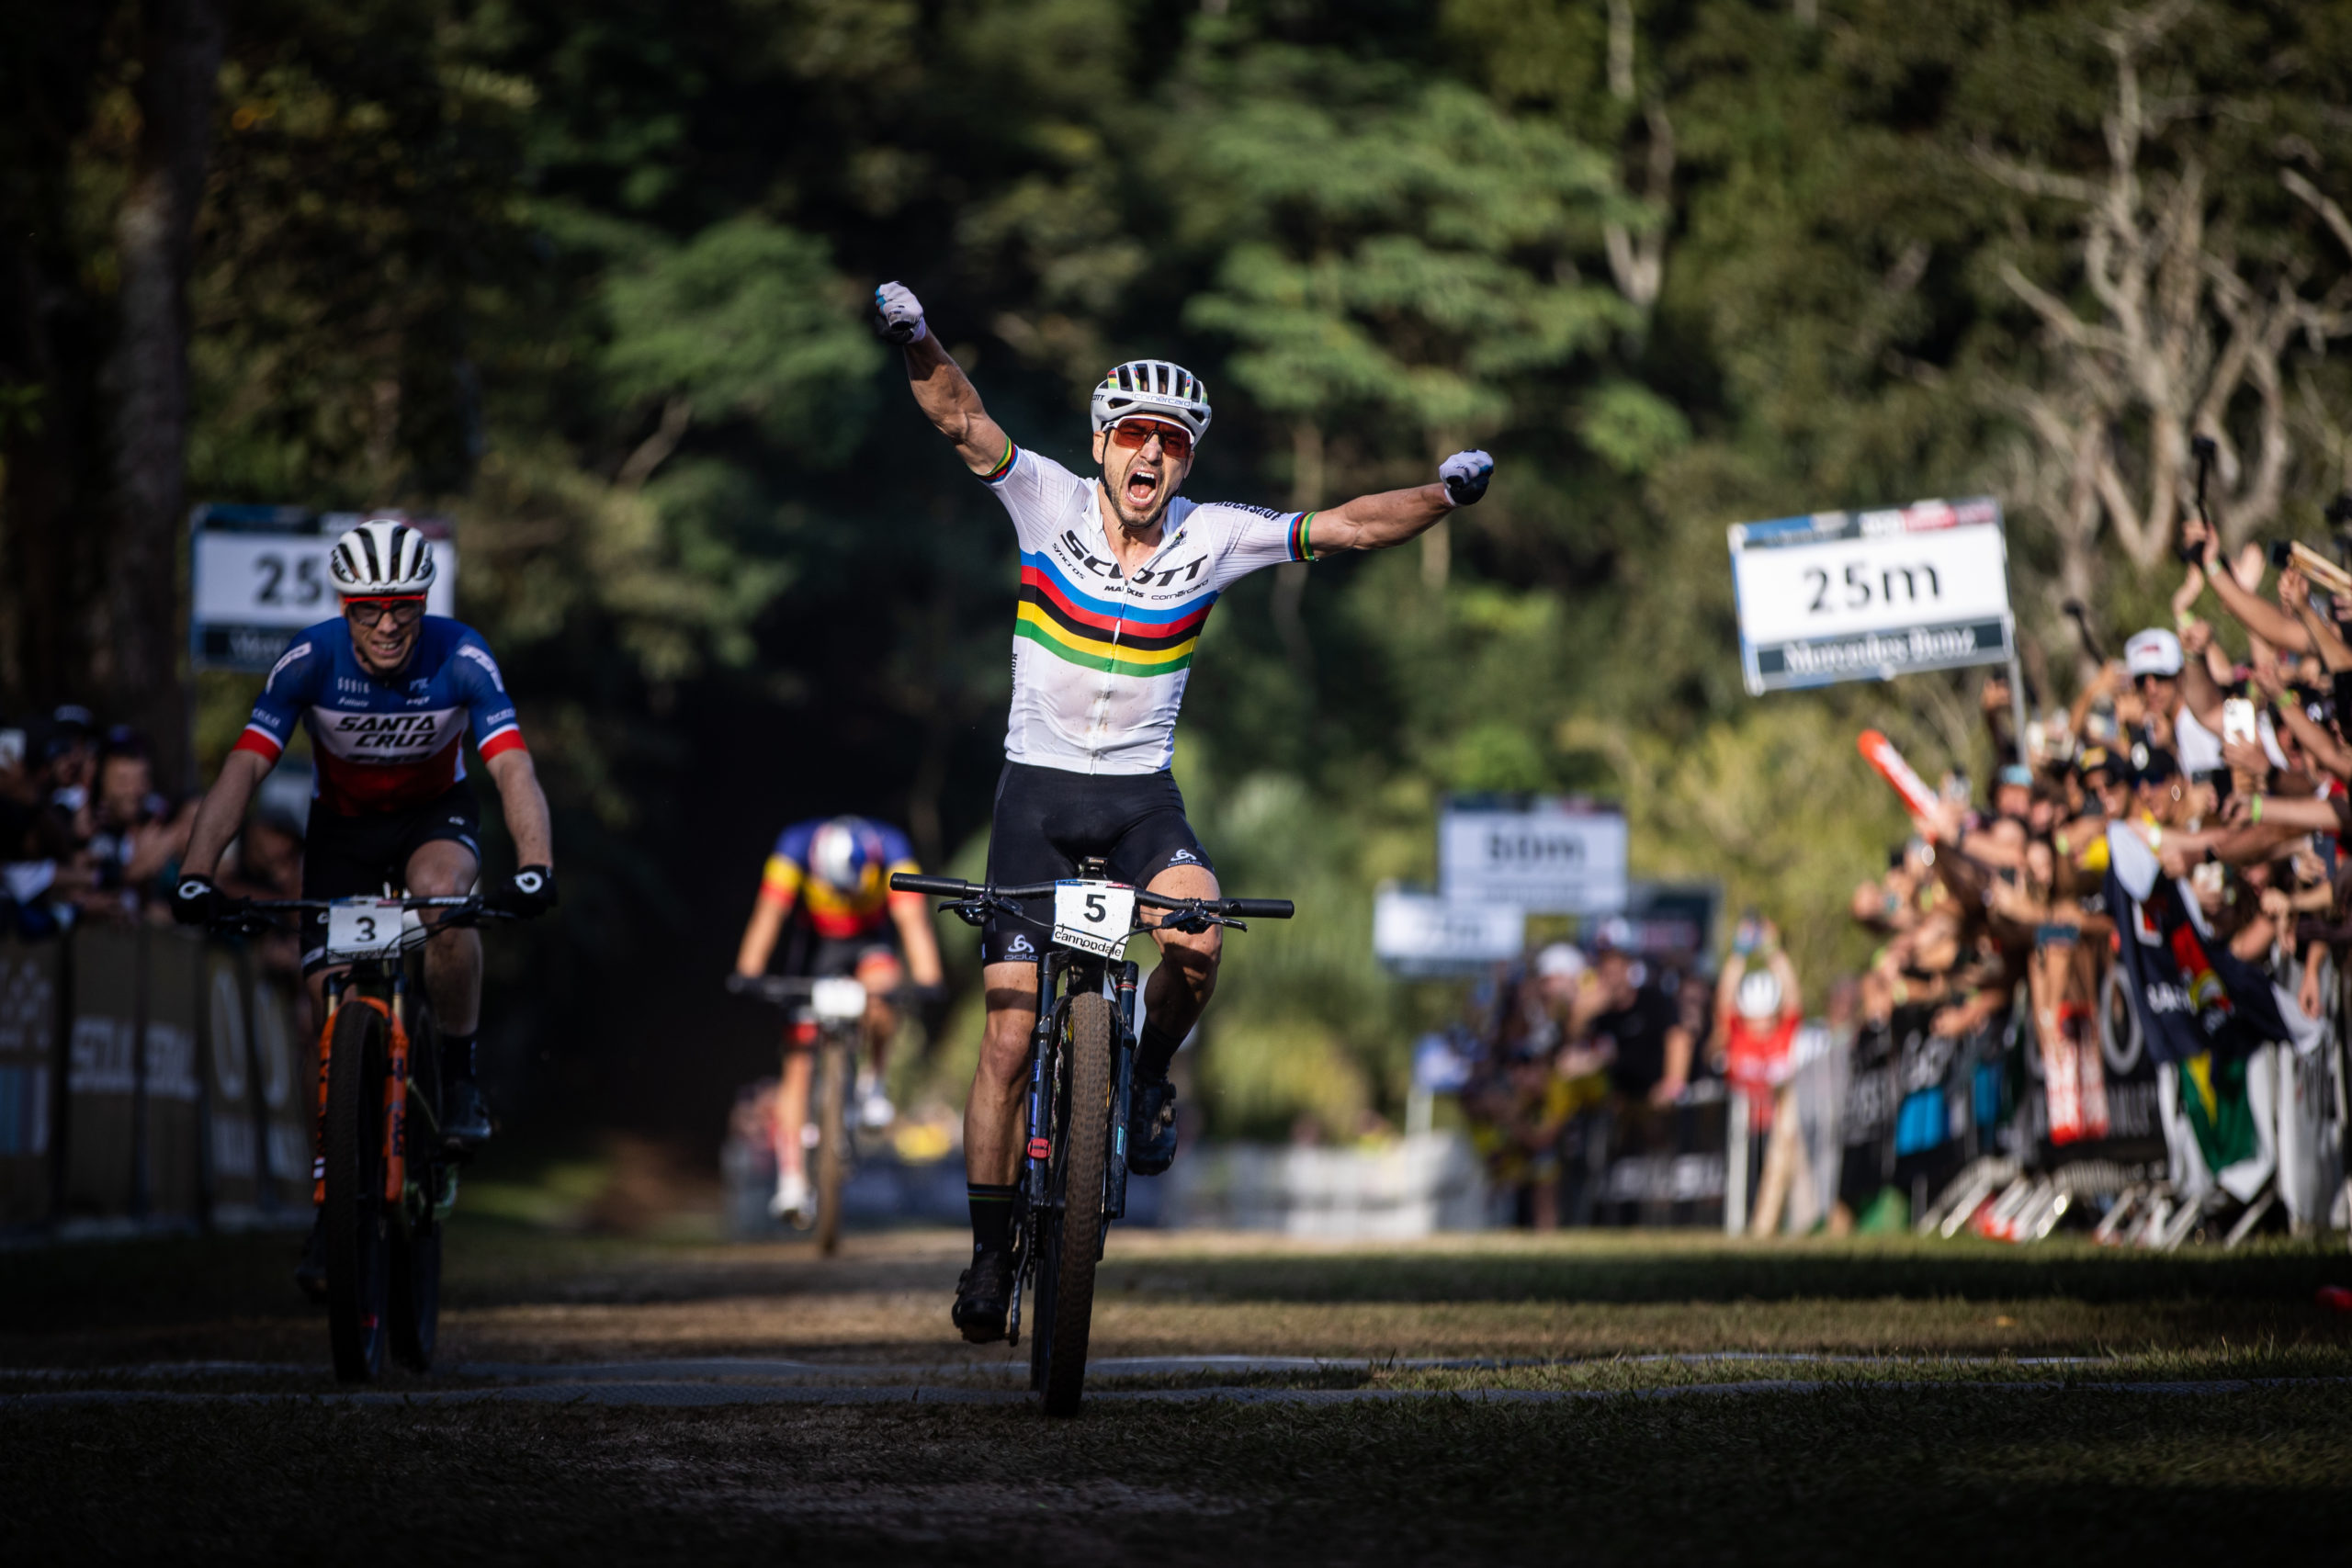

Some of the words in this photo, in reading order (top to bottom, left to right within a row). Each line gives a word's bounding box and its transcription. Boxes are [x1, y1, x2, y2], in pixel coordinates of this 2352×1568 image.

[1134, 393, 1192, 407] cornercard
[1052, 542, 1087, 581] syncros
[1060, 529, 1209, 587] SCOTT
[1150, 578, 1209, 602] cornercard
[1804, 562, 1940, 614] 25m
[334, 715, 435, 732] SANTA
[355, 731, 437, 749] CRUZ
[1083, 894, 1107, 923] 5
[355, 916, 377, 942] 3
[1054, 930, 1123, 958] cannondale
